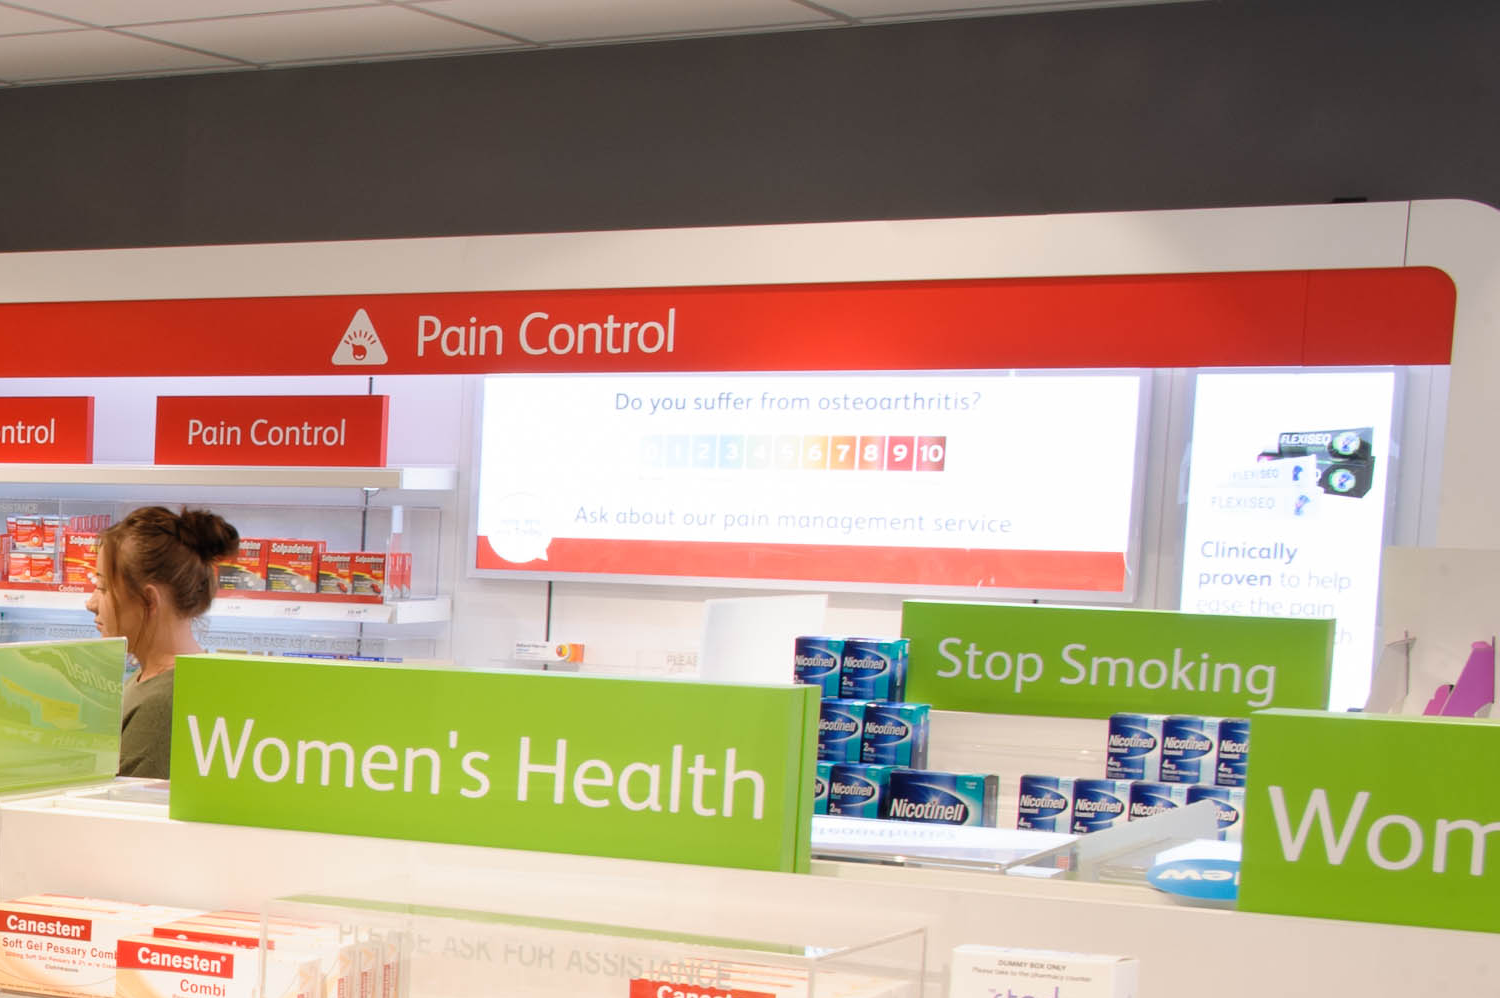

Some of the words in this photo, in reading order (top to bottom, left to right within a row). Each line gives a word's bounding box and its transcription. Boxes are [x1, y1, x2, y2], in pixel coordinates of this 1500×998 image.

[417, 315, 502, 357] Pain
[519, 308, 675, 355] Control
[615, 393, 643, 410] Do
[649, 395, 687, 415] you
[693, 391, 751, 411] suffer
[761, 391, 811, 411] from
[818, 391, 982, 412] osteoarthritis?
[188, 419, 242, 446] Pain
[250, 419, 346, 447] Control
[836, 445, 850, 462] 7
[864, 445, 878, 462] 8
[893, 445, 907, 462] 9
[921, 445, 943, 463] 10
[575, 506, 609, 525] Ask
[616, 508, 675, 526] about
[683, 511, 715, 527] our
[723, 511, 769, 531] pain
[778, 512, 925, 534] management
[934, 514, 1012, 533] service
[1201, 541, 1298, 565] Clinically
[1199, 572, 1272, 589] proven
[1280, 571, 1300, 588] to
[1308, 571, 1351, 590] help
[936, 637, 1044, 693] Stop
[1059, 642, 1276, 708] Smoking
[1109, 734, 1155, 750] Nicotinell
[187, 713, 491, 801] Women's
[517, 735, 767, 821] Health
[890, 798, 965, 820] Nicotinell
[1020, 794, 1066, 810] Nicotinell
[6, 915, 80, 937] Canesten
[2, 937, 23, 948] Soft
[26, 940, 43, 951] Gel
[47, 943, 87, 959] Pessary
